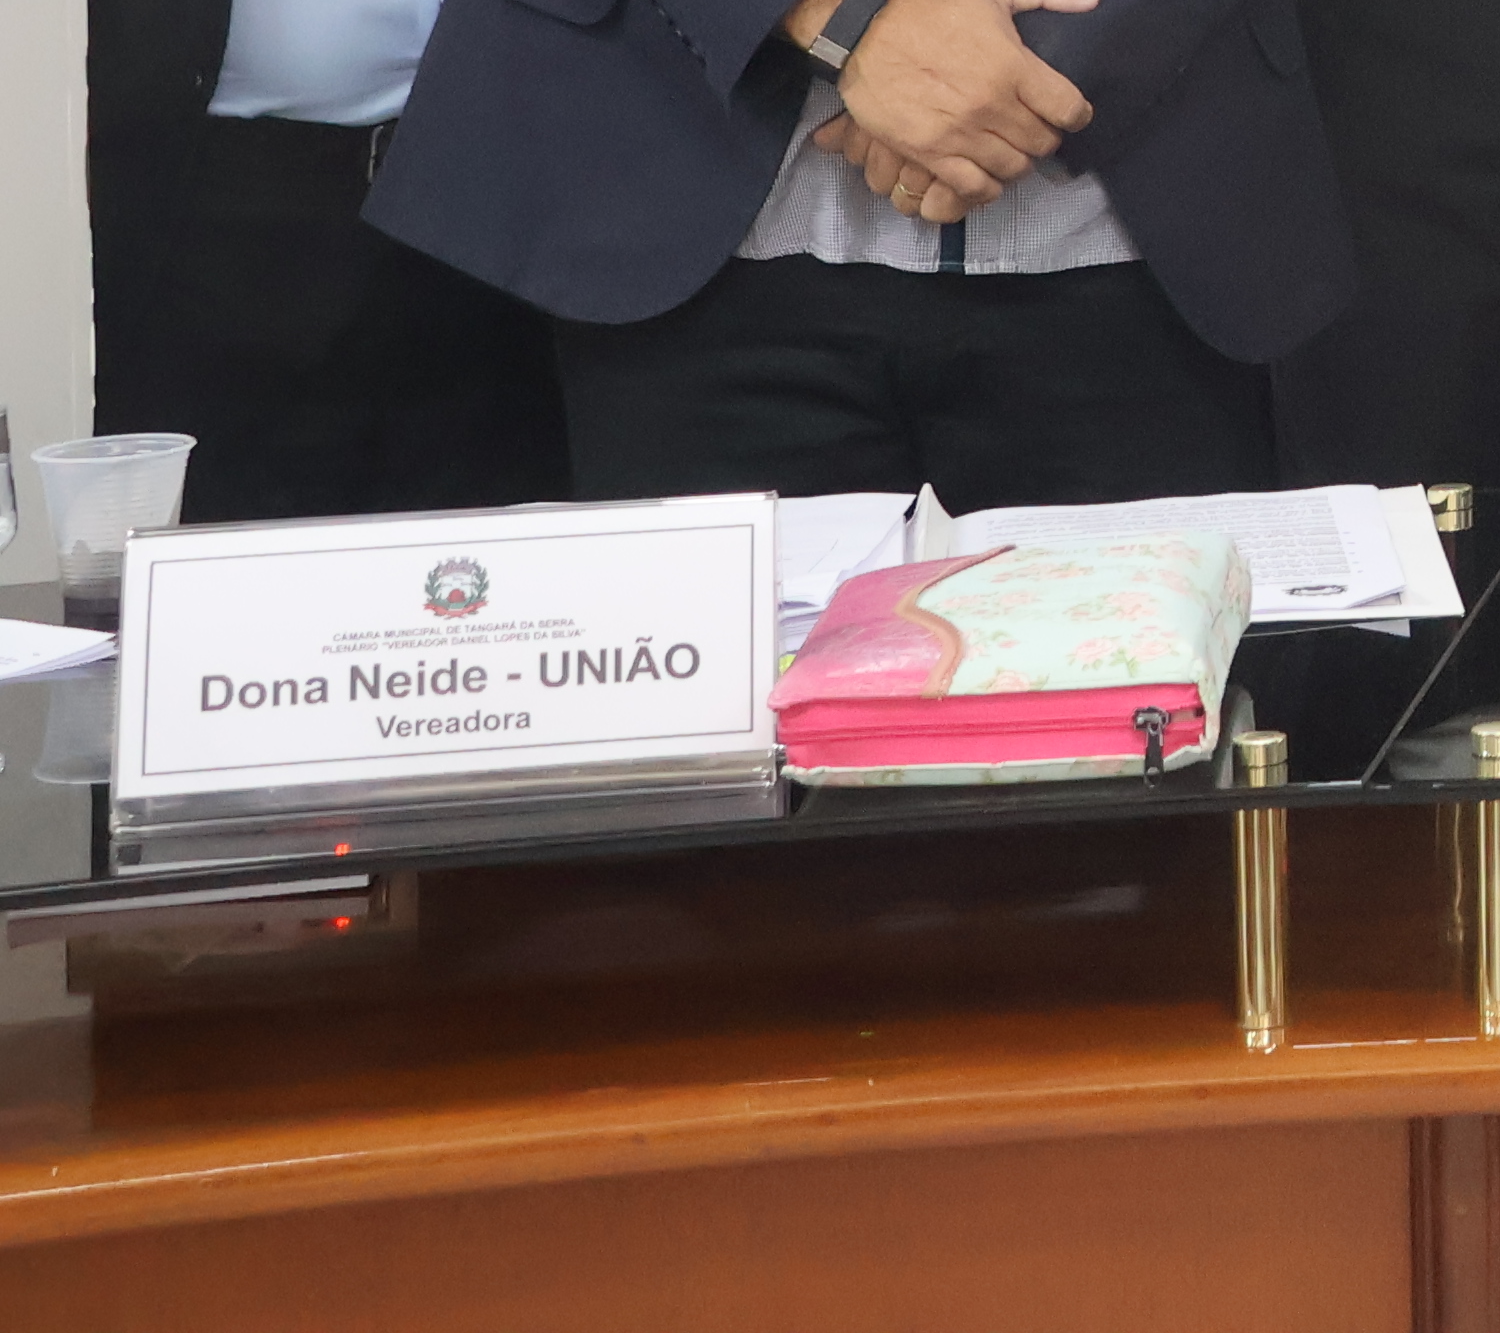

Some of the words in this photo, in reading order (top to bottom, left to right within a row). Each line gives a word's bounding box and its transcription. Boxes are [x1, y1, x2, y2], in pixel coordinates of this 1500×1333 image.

[322, 640, 378, 654] PLENÁRIO
[451, 634, 491, 646] DANIEL
[494, 632, 531, 644] LOPES
[534, 630, 549, 640] DA
[333, 630, 380, 642] CÂMARA
[384, 626, 442, 639] MUNICIPAL
[446, 624, 462, 635] DE
[465, 620, 517, 633] TANGARÁ
[520, 620, 535, 630] DA
[538, 618, 575, 628] SERRA
[199, 673, 330, 713] Dona
[348, 657, 489, 703] Neide
[538, 636, 701, 689] UNIÃO
[375, 710, 532, 740] Vereadora
